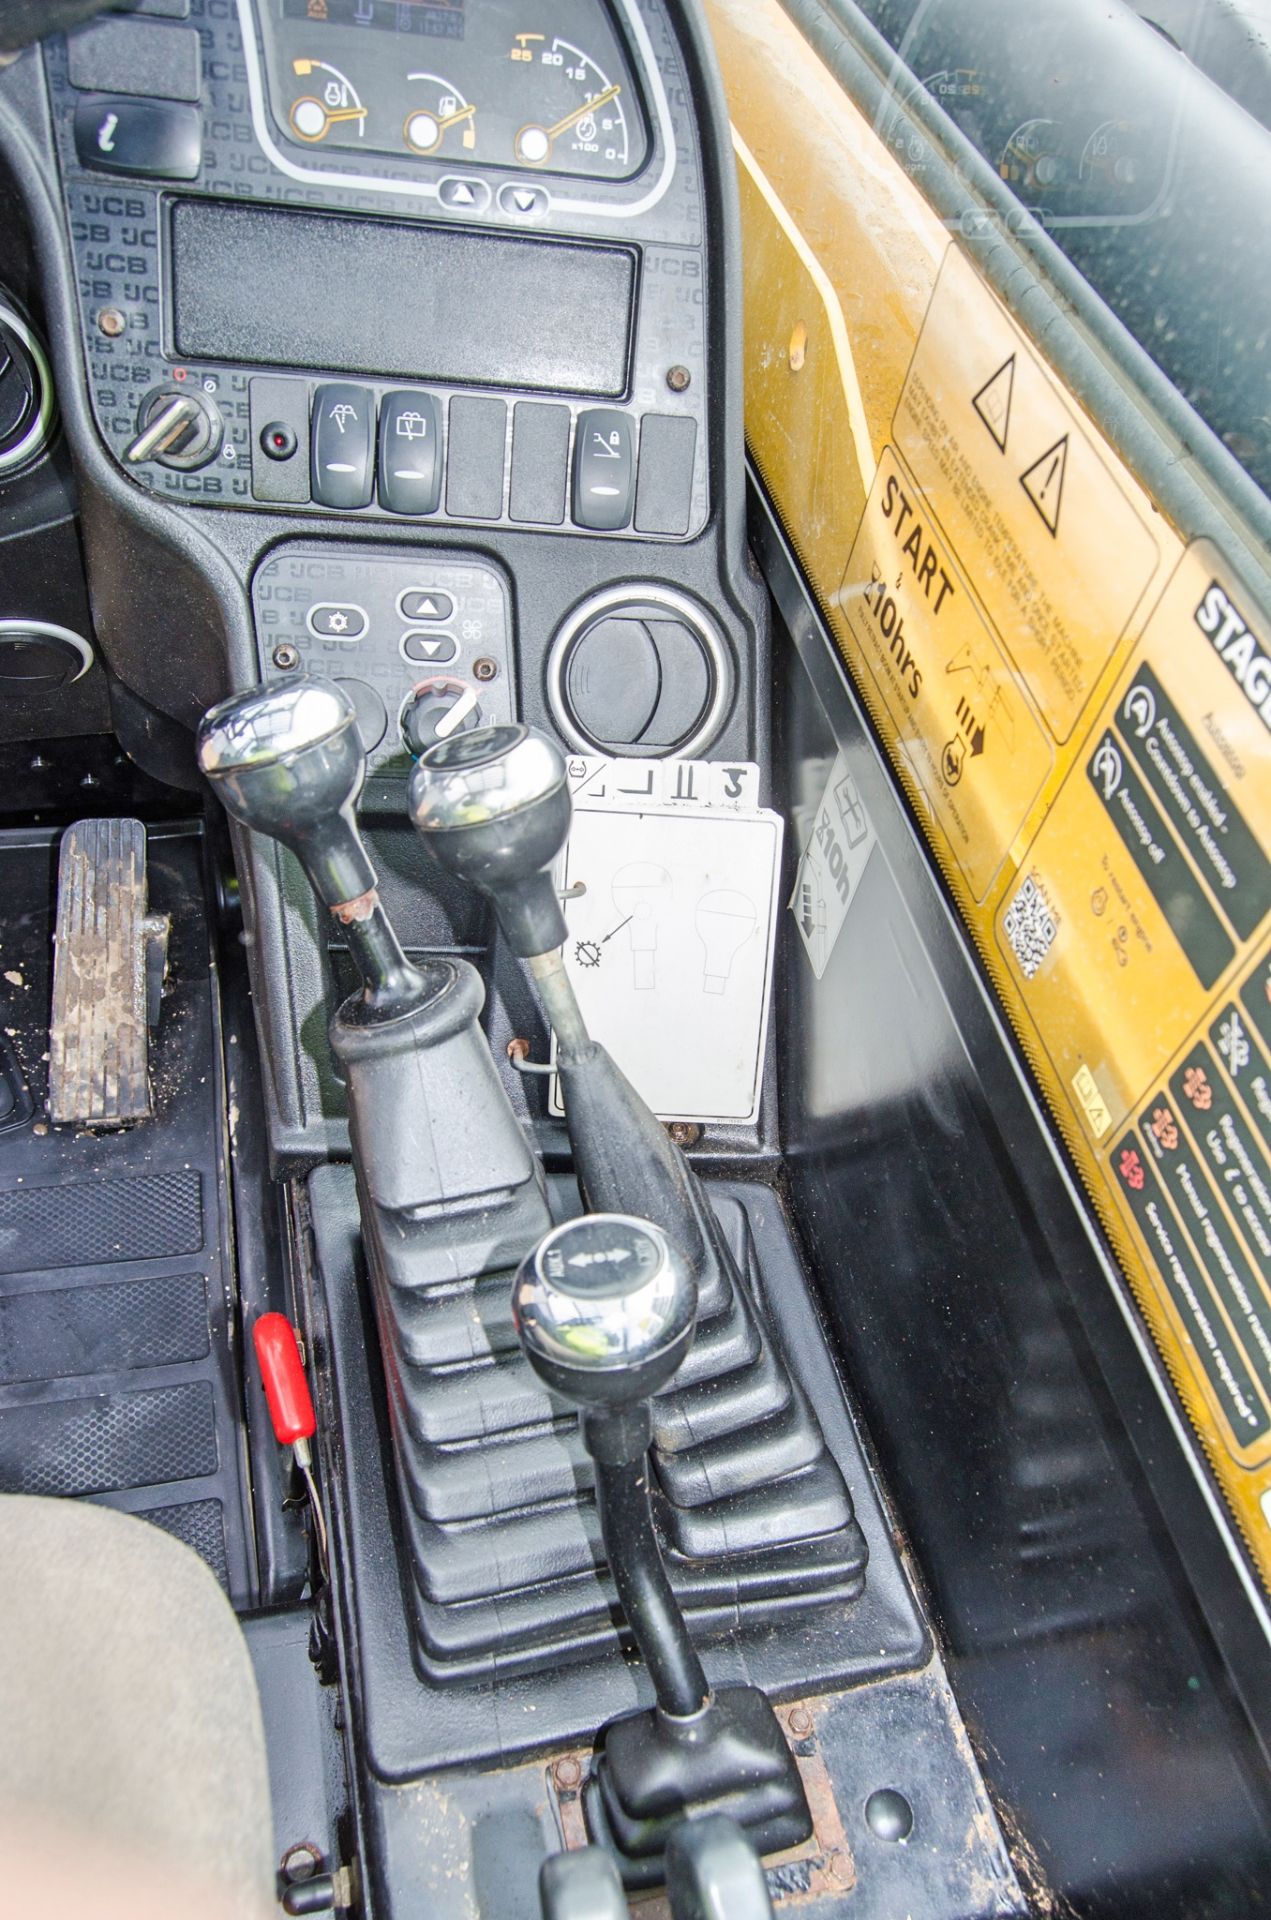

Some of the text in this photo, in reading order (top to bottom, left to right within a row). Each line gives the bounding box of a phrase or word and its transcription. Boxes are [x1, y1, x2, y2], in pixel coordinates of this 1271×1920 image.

[511, 48, 532, 61] 25
[541, 52, 563, 65] 20
[565, 68, 586, 80] 15
[602, 119, 613, 130] 5
[605, 149, 616, 159] 0
[84, 195, 146, 218] JCB
[72, 223, 157, 247] CB JC
[86, 252, 147, 274] JCB
[645, 256, 701, 278] JCB
[124, 284, 159, 304] JC
[91, 362, 151, 383] JCB
[165, 473, 222, 493] JCB
[881, 474, 955, 615] START
[872, 585, 923, 699] 10hrs
[1145, 1201, 1173, 1255] Service
